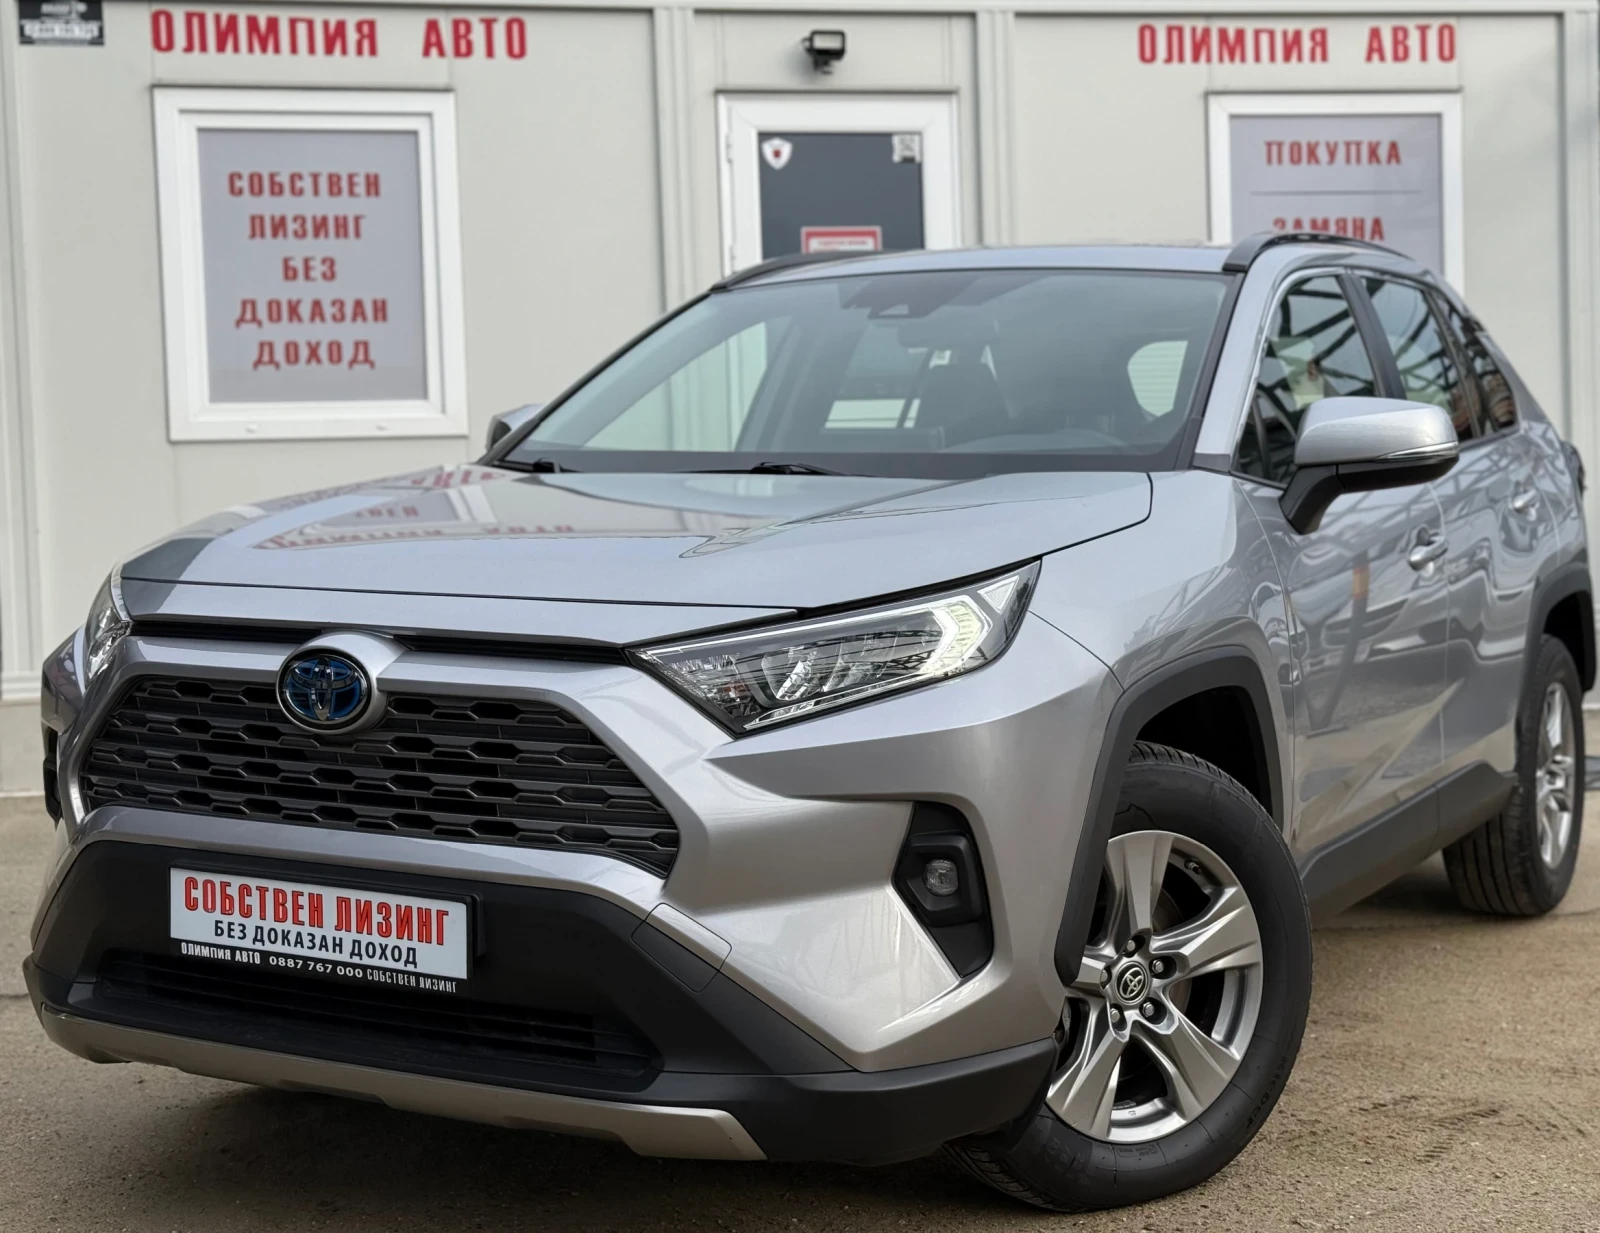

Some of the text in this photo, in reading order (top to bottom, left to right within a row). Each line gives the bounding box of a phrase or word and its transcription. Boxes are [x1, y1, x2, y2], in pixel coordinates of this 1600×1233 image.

[151, 10, 378, 58] ОЛИМПИЯ
[422, 17, 527, 59] АВТО
[1138, 24, 1457, 64] ОЛИМПИЯ АВТО
[1264, 140, 1402, 166] ПОКУПКА
[227, 171, 381, 198] СОБСТВЕН
[249, 213, 366, 240] ЛИЗИНГ
[282, 256, 337, 282] БЕЗ
[235, 298, 388, 329] ДОКАЗАН
[253, 339, 375, 371] ДОХОД
[184, 876, 449, 946] СОБСТВЕН ЛИЗИНГ
[214, 919, 418, 969] БЕЗ ДОКАЗАН ДОХОД
[180, 942, 457, 993] ОЛИМПИЯ АВТО 0887 767 000 СОБСТВЕН ЛИЗИНГ
